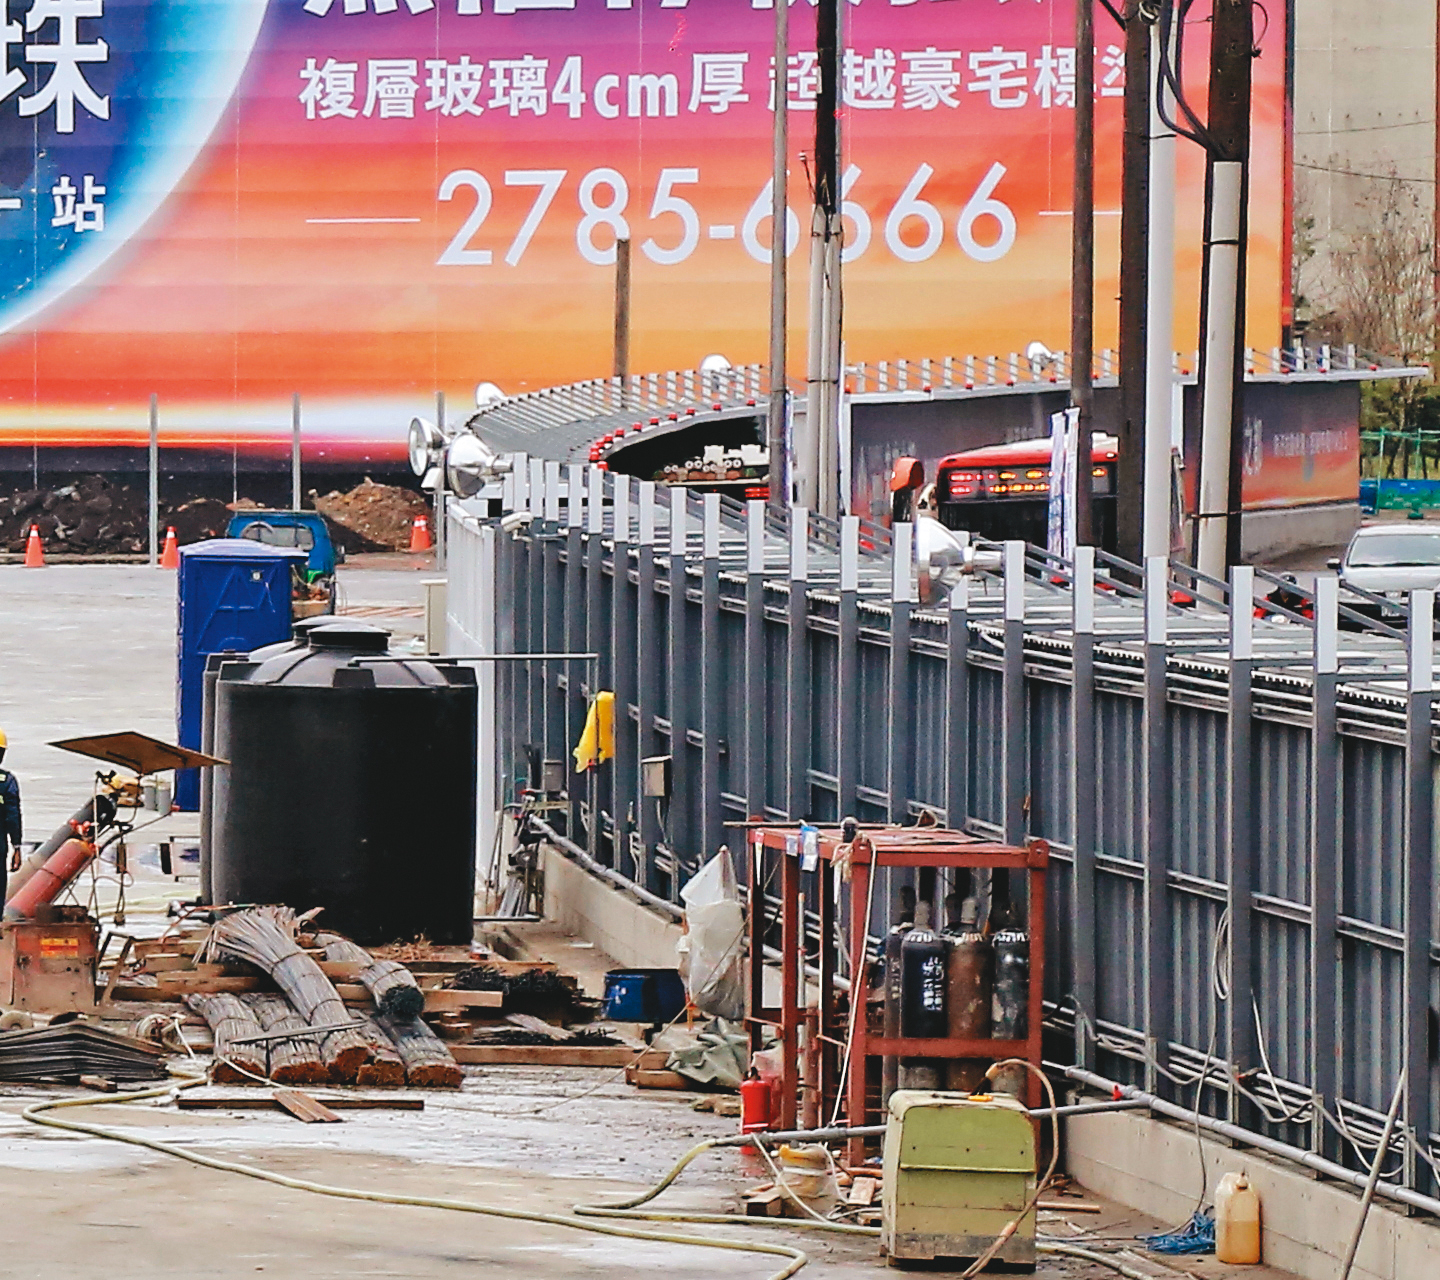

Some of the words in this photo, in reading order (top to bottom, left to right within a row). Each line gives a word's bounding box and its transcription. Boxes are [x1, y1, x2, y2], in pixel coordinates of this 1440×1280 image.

[299, 50, 749, 119] 複層玻璃4cm厚
[436, 161, 1018, 267] 2785-6666
